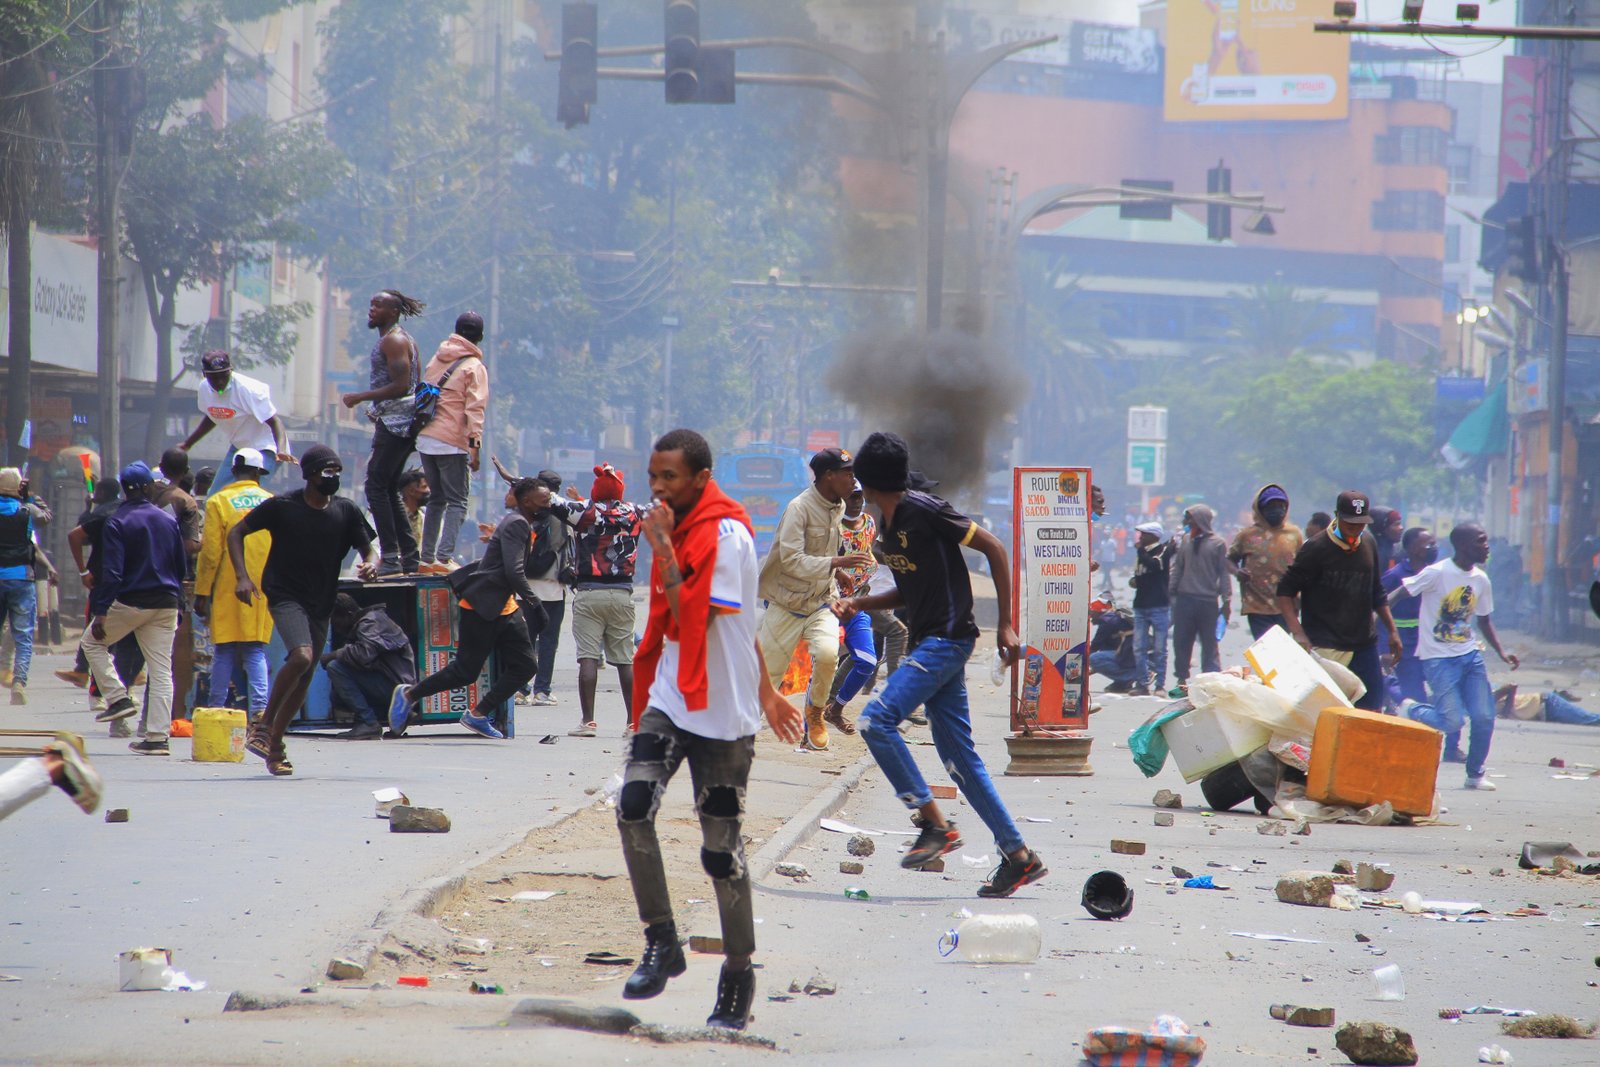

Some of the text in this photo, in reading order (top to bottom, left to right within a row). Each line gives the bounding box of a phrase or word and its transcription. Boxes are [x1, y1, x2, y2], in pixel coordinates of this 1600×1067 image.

[35, 276, 87, 326] Galaxy S24 Series
[1031, 477, 1058, 491] ROUTE
[1027, 494, 1046, 505] KMO
[1057, 495, 1080, 504] DIGITAL
[1025, 506, 1049, 516] SACCO
[1053, 507, 1074, 516] LUXURY
[1038, 529, 1076, 539] New Route Alert
[1034, 545, 1081, 558] WESTLANDS
[1041, 563, 1076, 576] KANGEMI
[1044, 582, 1073, 595] UTHIRU
[1047, 600, 1071, 613] KINOO
[1045, 619, 1070, 632] REGEN
[1042, 637, 1071, 651] KIKUYU
